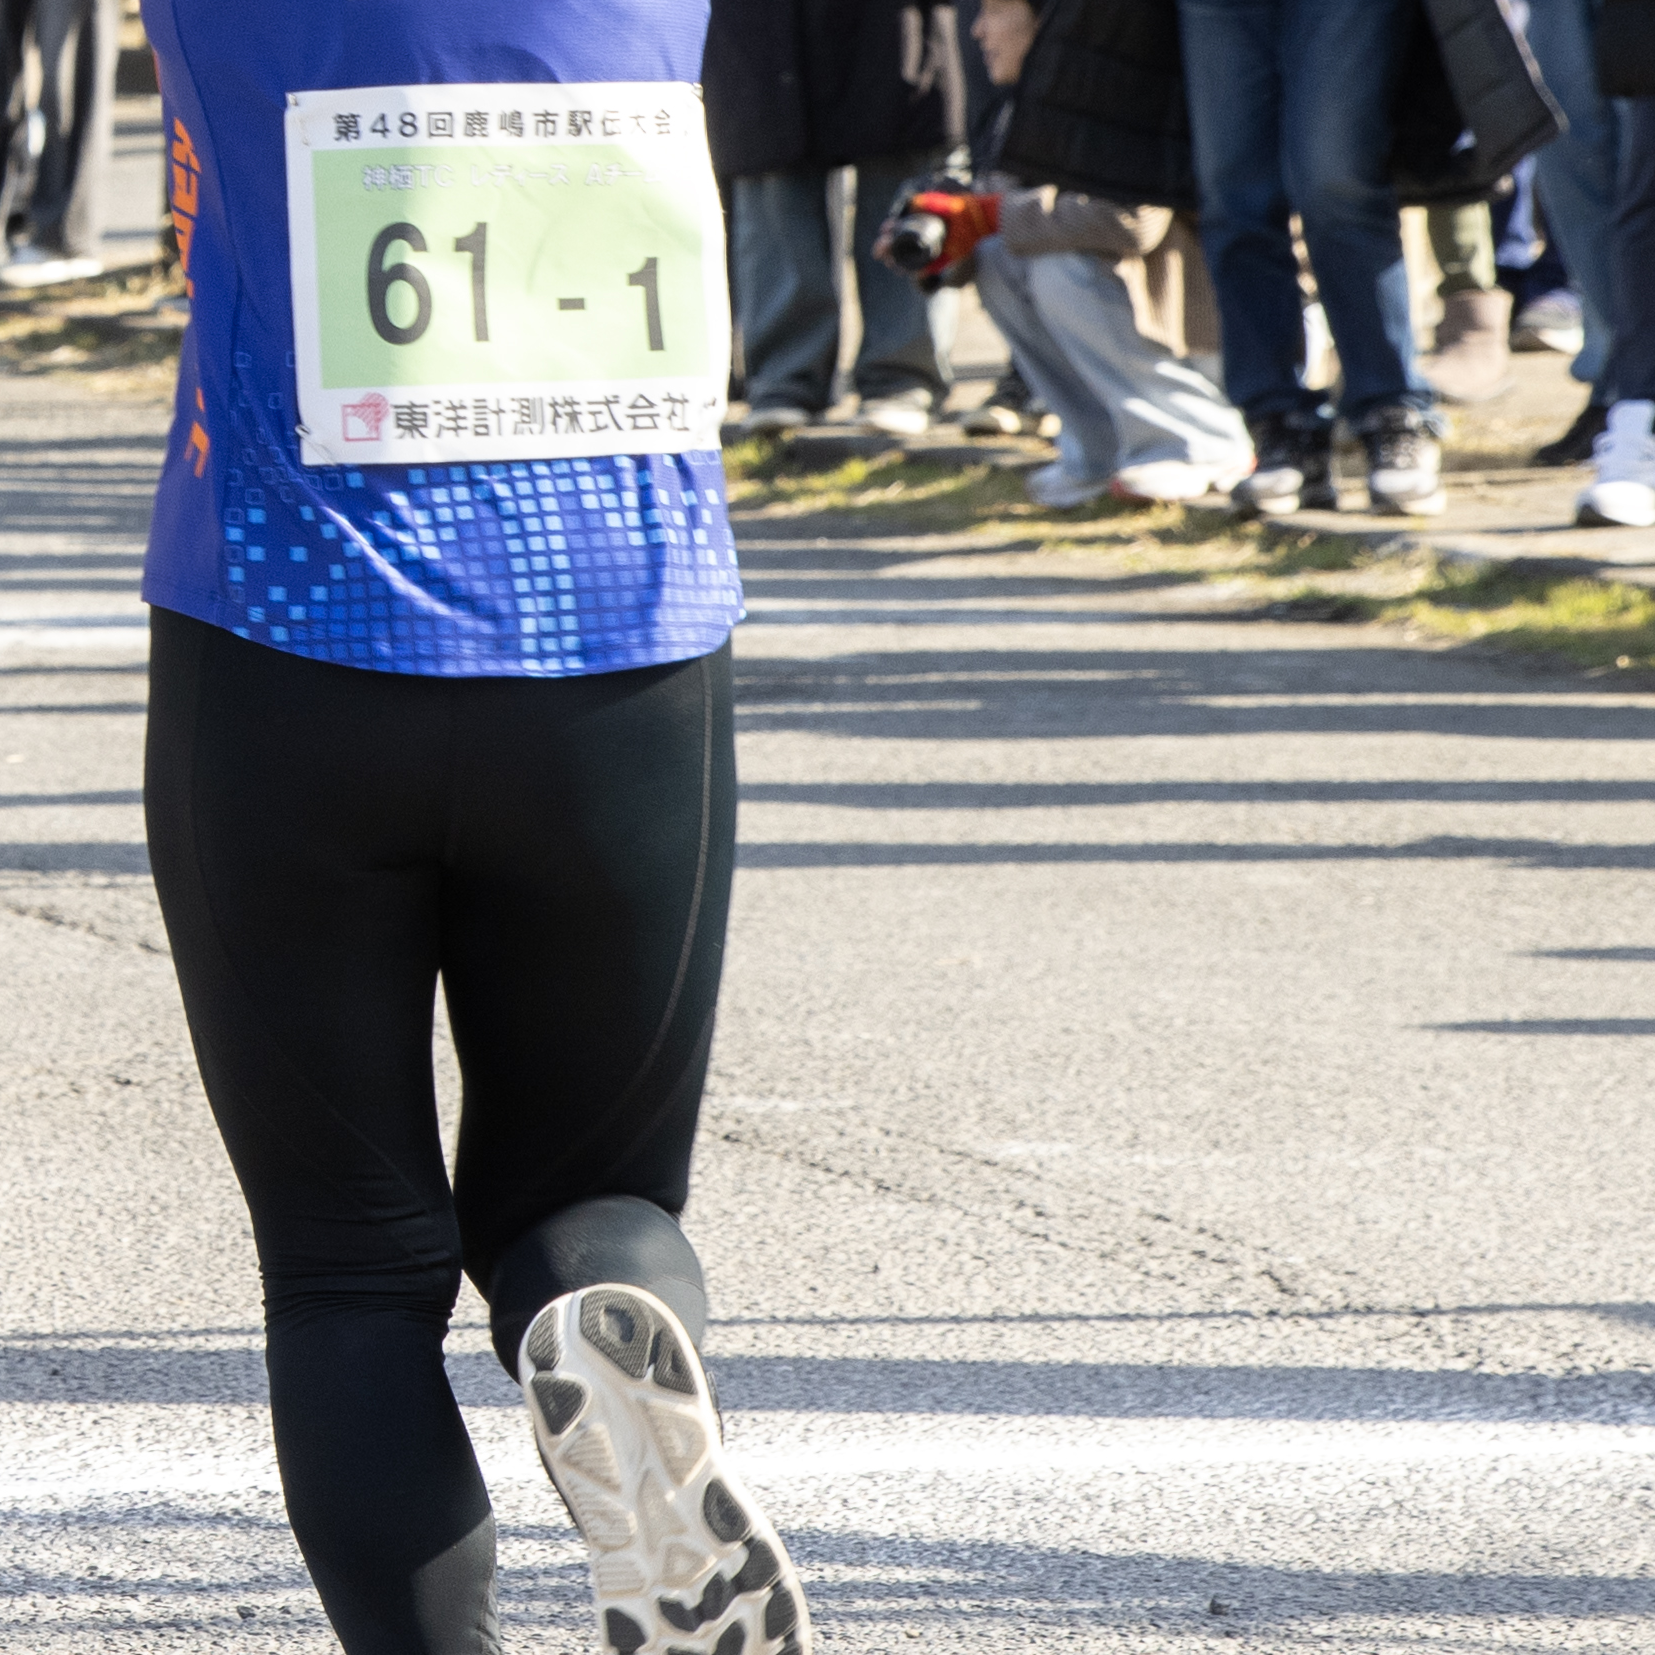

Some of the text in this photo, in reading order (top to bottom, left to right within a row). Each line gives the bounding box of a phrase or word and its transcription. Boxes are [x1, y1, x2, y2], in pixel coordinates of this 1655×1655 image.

[332, 109, 672, 142] 第48回鹿嶋市駅伝大会
[362, 163, 452, 192] 神栖TC
[391, 393, 690, 439] 東洋計測株式会社
